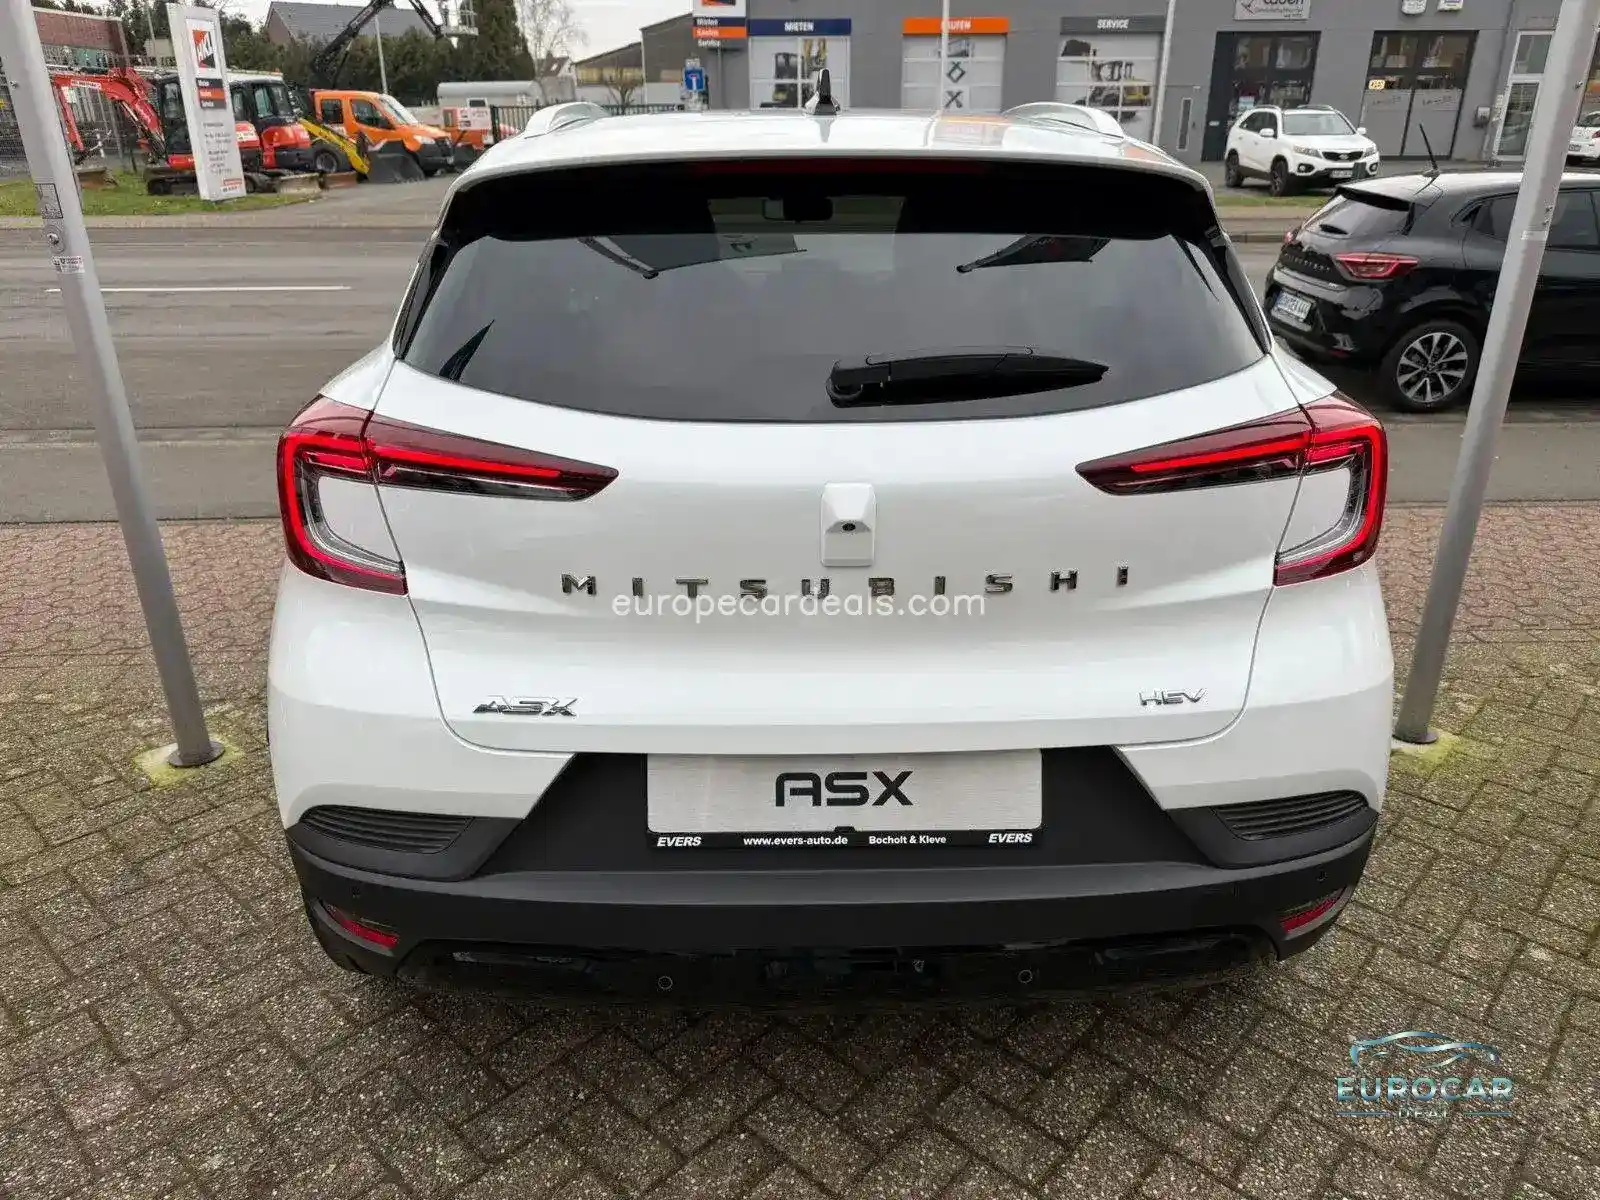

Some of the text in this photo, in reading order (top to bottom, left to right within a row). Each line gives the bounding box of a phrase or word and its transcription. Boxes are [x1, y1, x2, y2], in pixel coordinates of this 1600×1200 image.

[784, 21, 814, 32] MIETEN
[941, 20, 972, 31] AUFEN
[1097, 18, 1129, 29] SERVICE
[561, 565, 1130, 600] MITSUBISHI
[1138, 688, 1206, 706] HEV
[472, 695, 579, 717] ASX
[775, 770, 914, 807] ASX
[656, 836, 702, 847] EVERS
[743, 834, 947, 847] www.evers-auto.de Bocholt & Kleve
[988, 832, 1033, 843] EVERS
